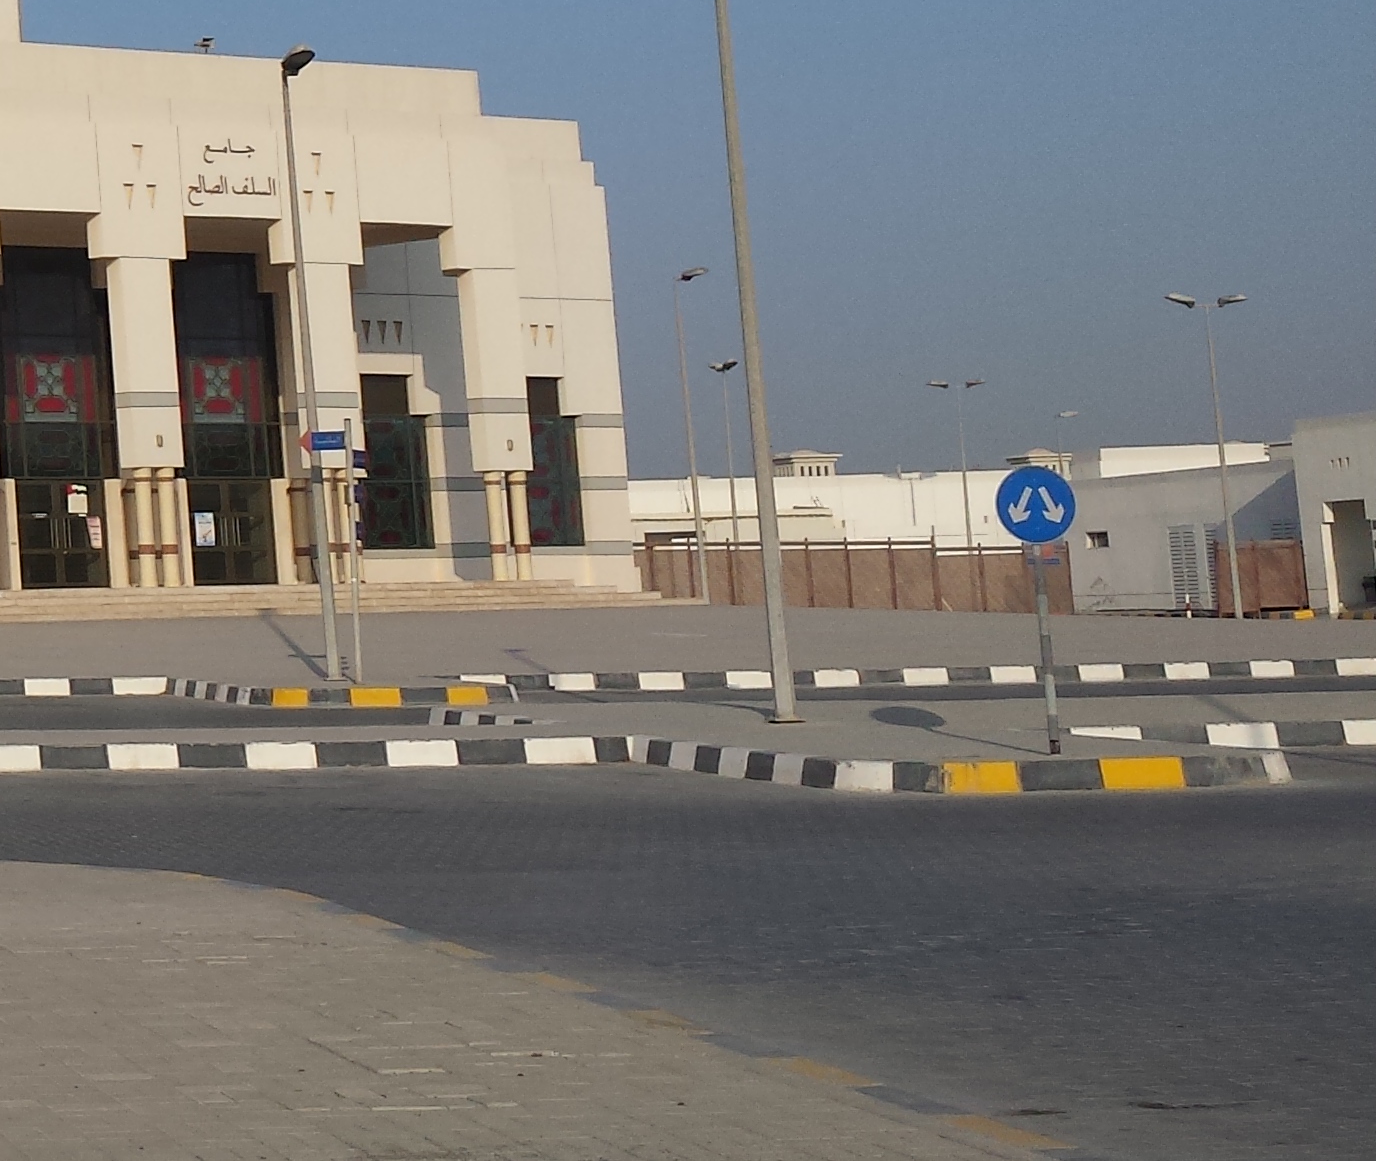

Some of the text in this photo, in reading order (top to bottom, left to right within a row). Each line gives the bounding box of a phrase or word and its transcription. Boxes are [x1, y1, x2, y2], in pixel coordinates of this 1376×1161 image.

[203, 138, 256, 164] جامع
[187, 173, 276, 207] السلف الصالح
